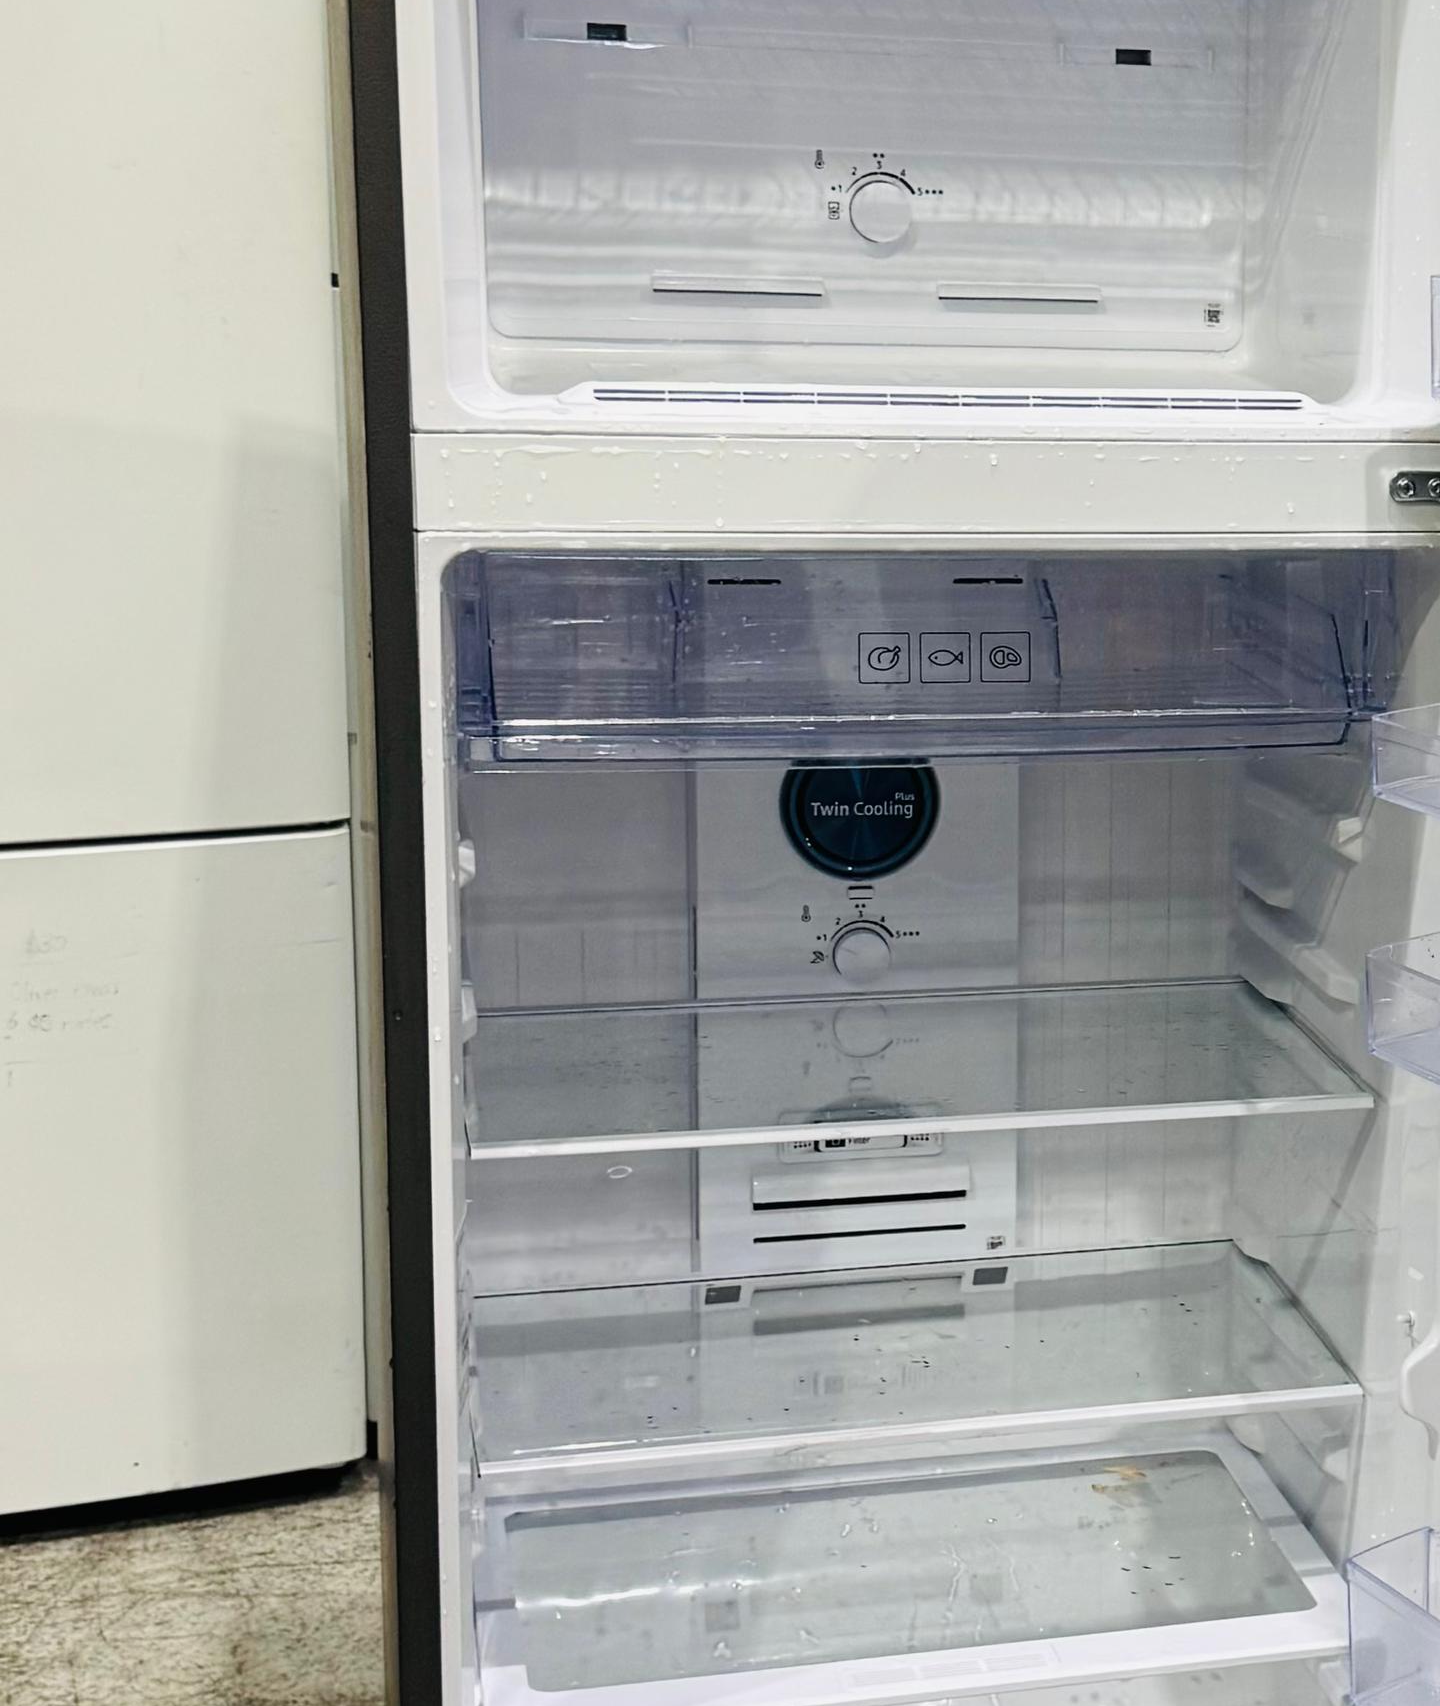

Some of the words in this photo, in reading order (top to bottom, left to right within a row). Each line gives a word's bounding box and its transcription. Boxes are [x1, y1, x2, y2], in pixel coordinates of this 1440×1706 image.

[895, 791, 916, 801] Plus
[810, 801, 850, 817] Twin
[854, 800, 914, 819] Cooling
